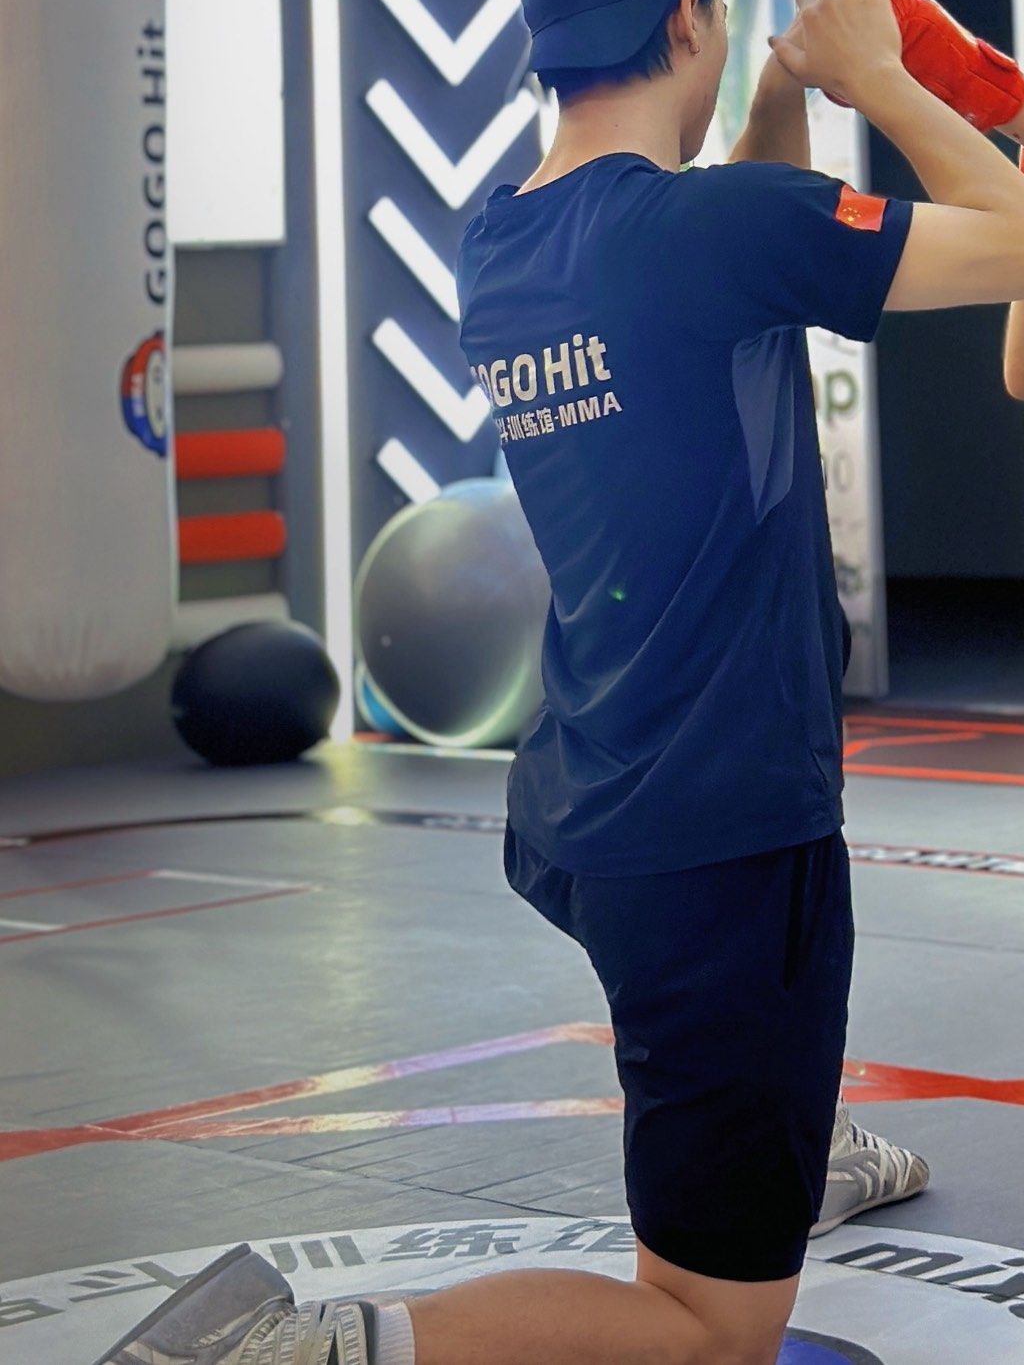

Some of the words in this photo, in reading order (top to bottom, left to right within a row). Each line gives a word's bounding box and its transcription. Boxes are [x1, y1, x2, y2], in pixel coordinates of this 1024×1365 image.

[136, 20, 165, 106] Hit
[143, 123, 167, 306] GOGO
[543, 333, 612, 395] Hit
